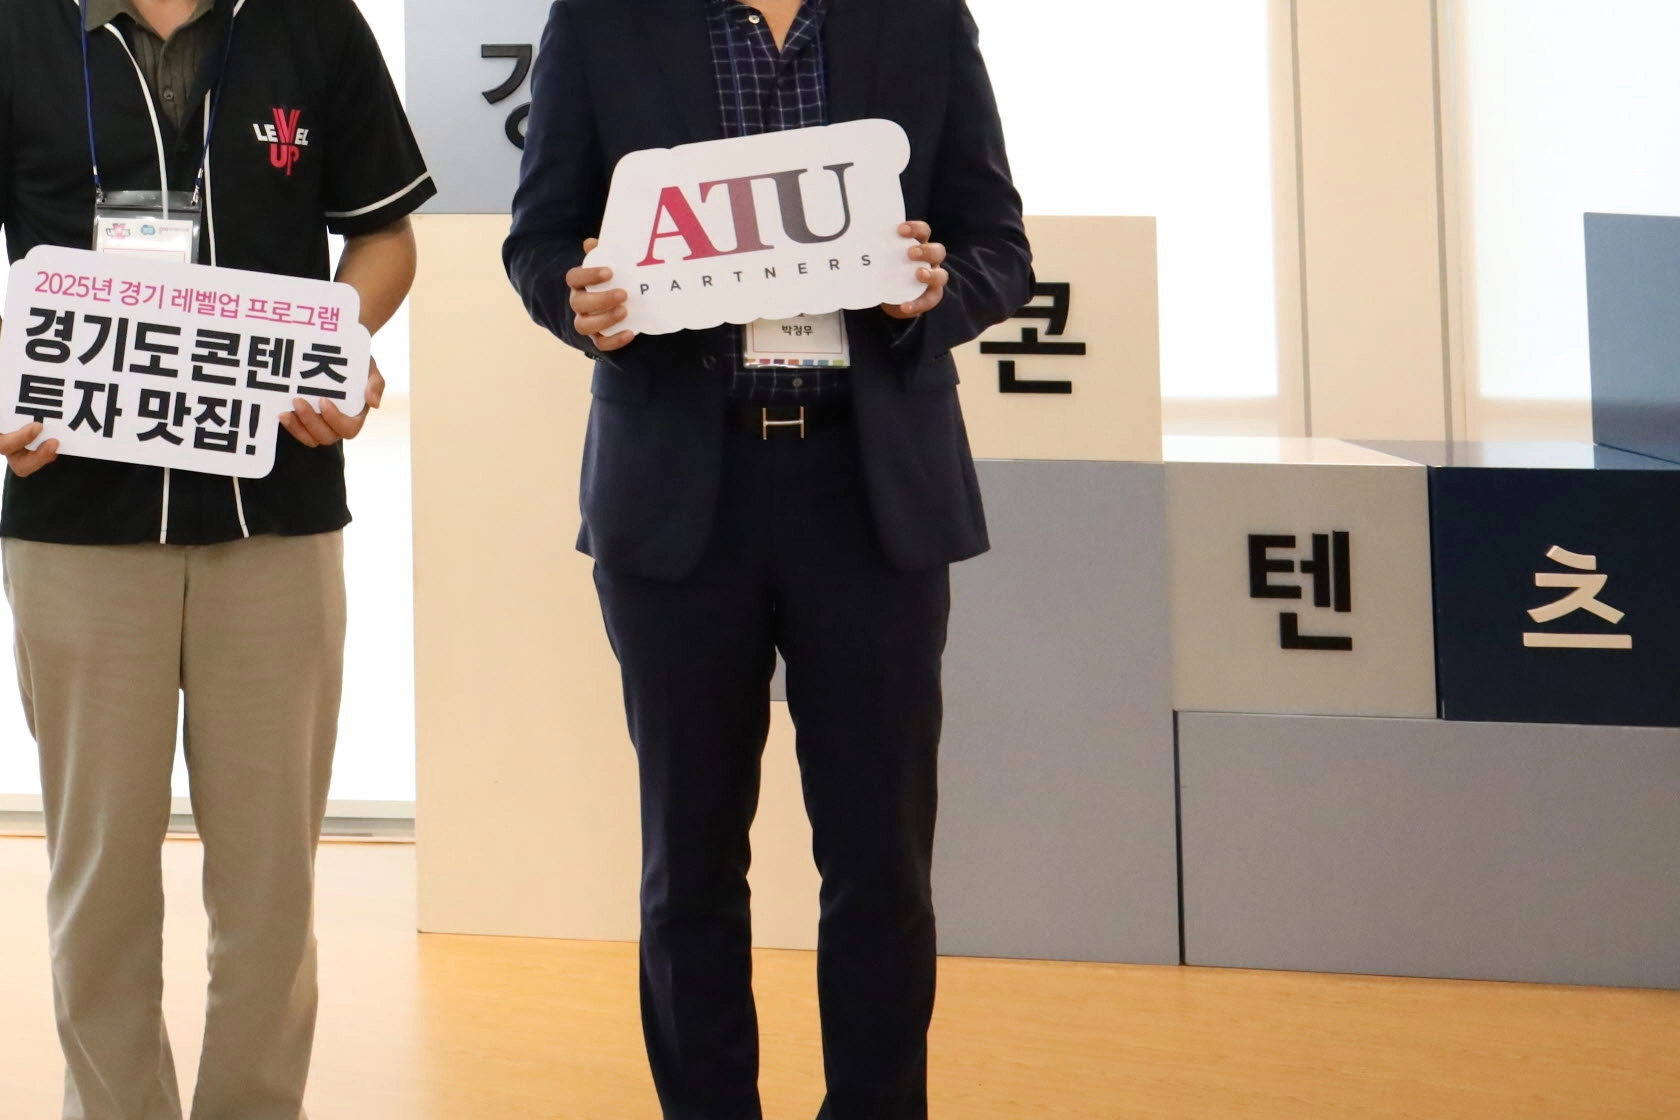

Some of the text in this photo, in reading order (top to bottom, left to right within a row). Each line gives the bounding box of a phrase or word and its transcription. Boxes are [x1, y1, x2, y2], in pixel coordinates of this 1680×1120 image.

[252, 107, 309, 146] LEVEL
[269, 142, 300, 176] UP
[636, 161, 855, 268] ATU
[34, 270, 341, 333] 2025년 경기 레벨업 프로그램
[640, 253, 872, 296] PARTNERS
[980, 281, 1087, 394] 콘
[14, 373, 262, 456] 투자 맛집!
[1247, 529, 1353, 651] 텐
[1522, 544, 1632, 649] 츠
